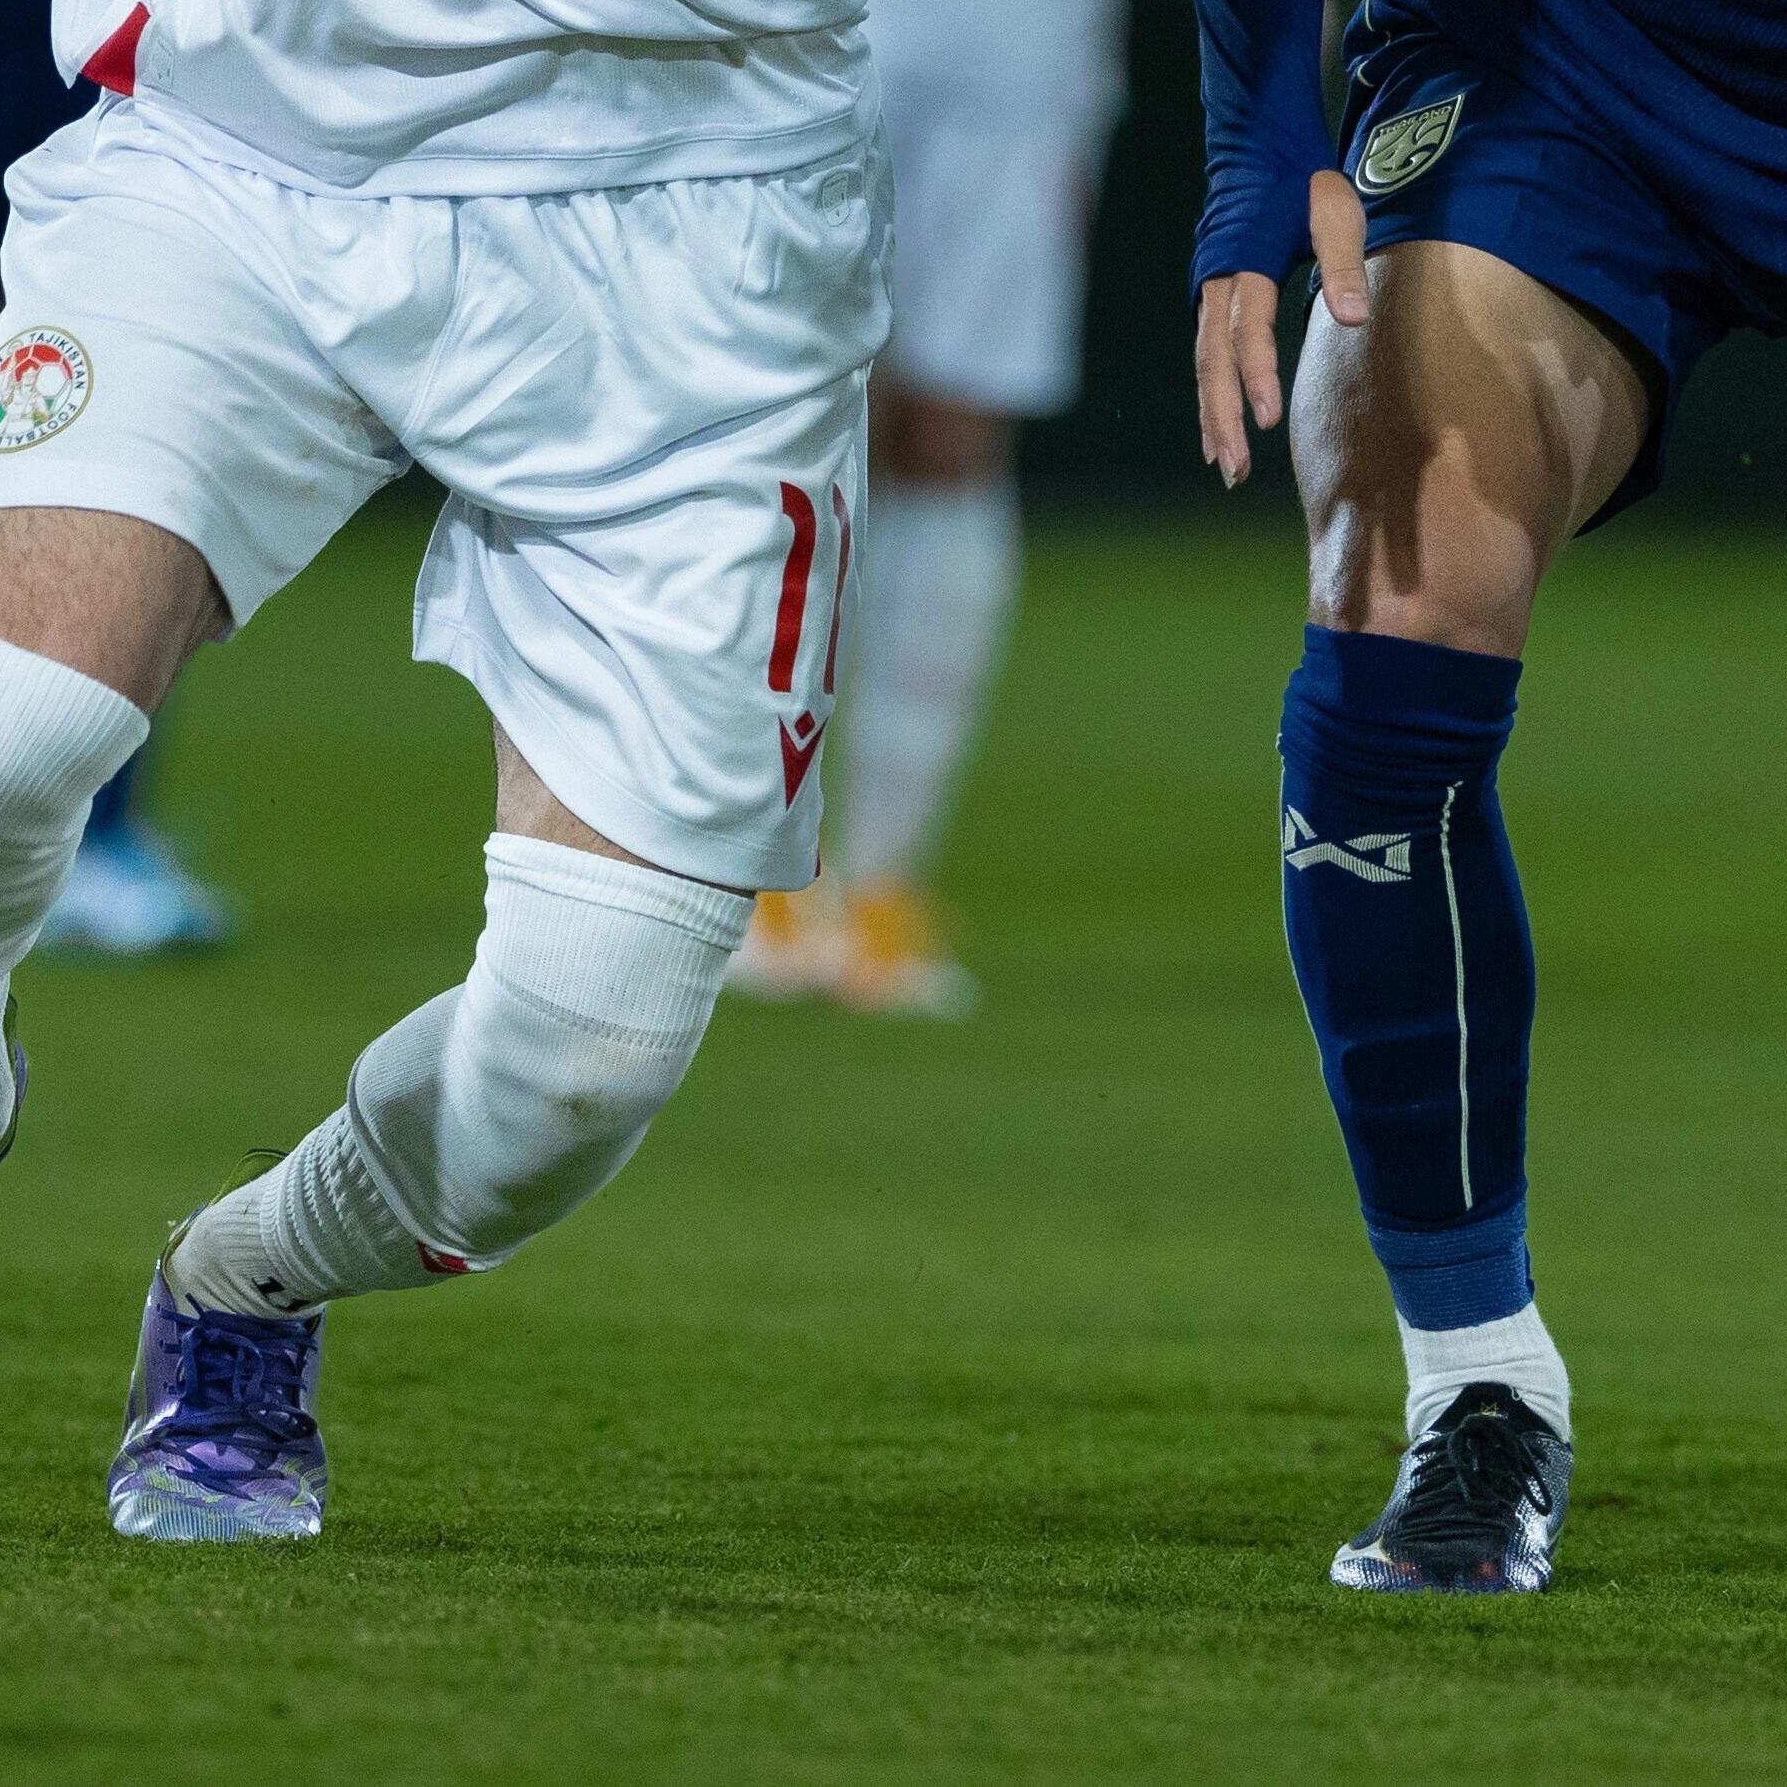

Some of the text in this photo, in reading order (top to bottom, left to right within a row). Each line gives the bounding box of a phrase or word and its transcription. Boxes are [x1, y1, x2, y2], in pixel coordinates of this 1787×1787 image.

[1379, 105, 1452, 135] THAILAND
[29, 332, 87, 390] TAJIKISTAN
[768, 481, 851, 695] 11
